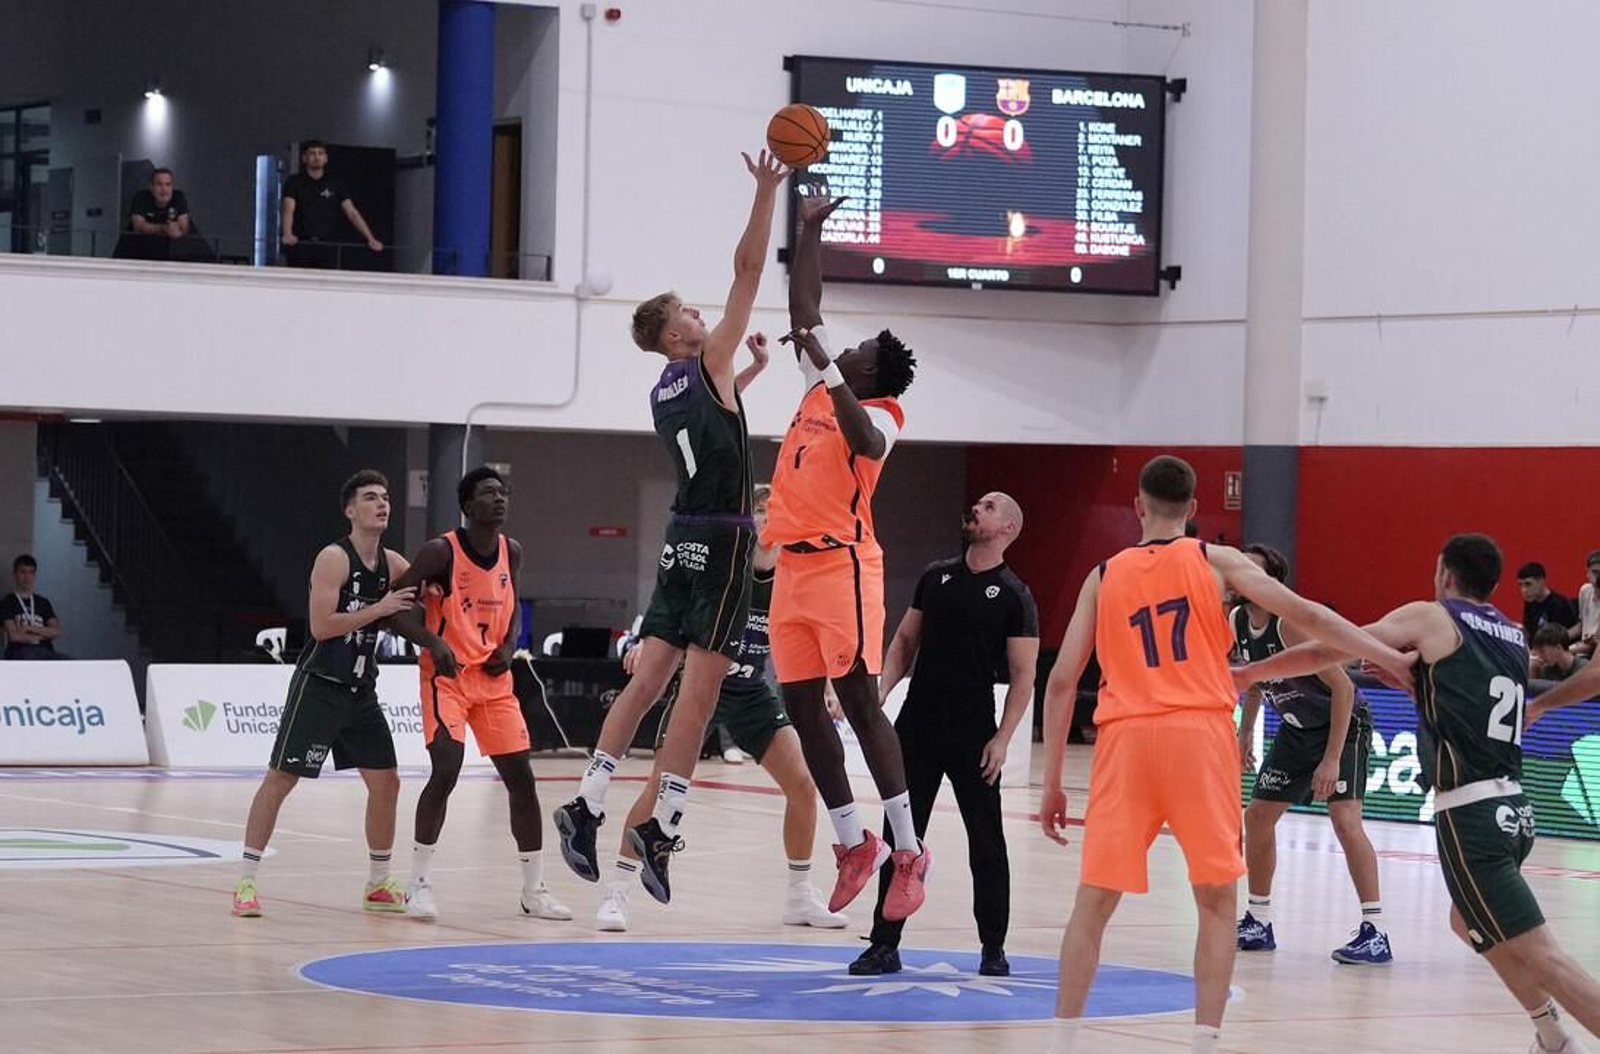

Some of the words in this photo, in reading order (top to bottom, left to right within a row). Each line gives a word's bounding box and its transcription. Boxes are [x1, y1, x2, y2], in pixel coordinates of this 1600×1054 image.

[845, 77, 914, 97] UNICAJA
[1051, 88, 1146, 110] BARCELONA
[936, 115, 958, 148] 0
[1002, 119, 1024, 152] 0
[1091, 156, 1119, 167] POZA
[1091, 200, 1143, 213] GONZALEZ
[872, 257, 885, 275] 0
[966, 268, 1009, 283] CUARTO
[1070, 267, 1083, 284] 0
[676, 428, 698, 479] 1
[676, 542, 709, 555] COSTA
[477, 622, 490, 646] 7
[1129, 595, 1191, 668] 17
[0, 698, 105, 734] nicaja
[1487, 675, 1525, 747] 21
